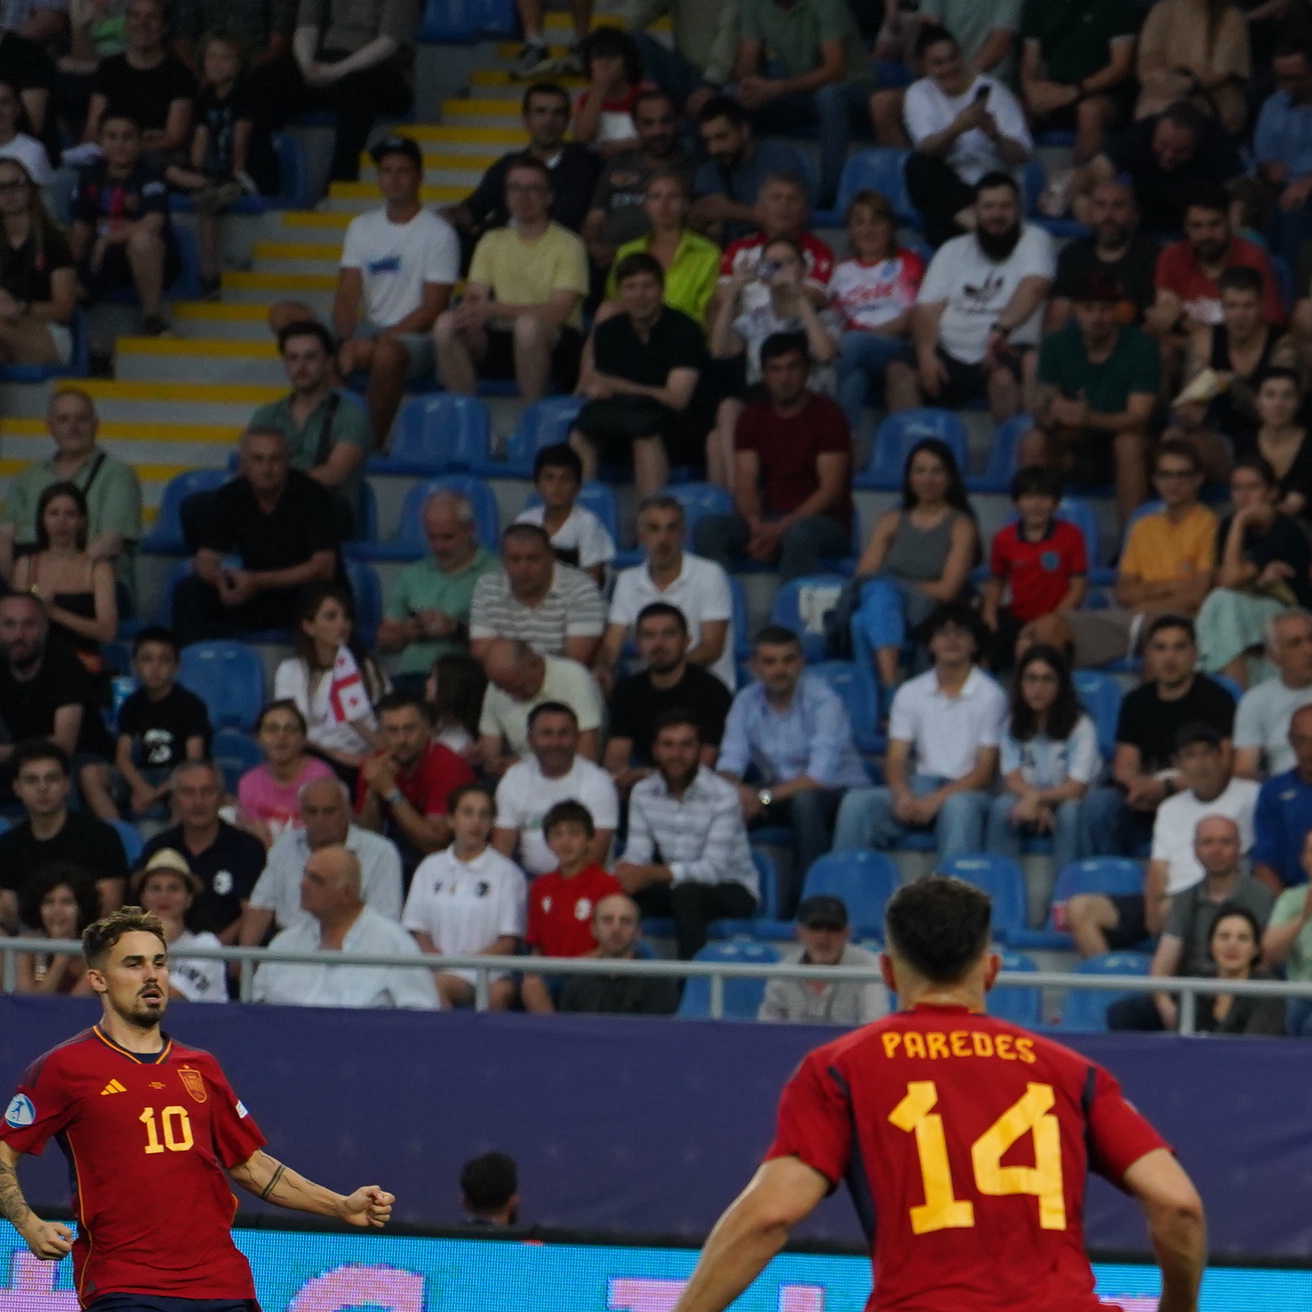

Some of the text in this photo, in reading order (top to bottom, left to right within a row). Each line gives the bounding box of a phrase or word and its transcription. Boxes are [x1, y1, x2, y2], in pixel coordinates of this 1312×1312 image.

[882, 1030, 1037, 1064] PAREDES
[139, 1105, 195, 1154] 10
[888, 1081, 1067, 1235] 14
